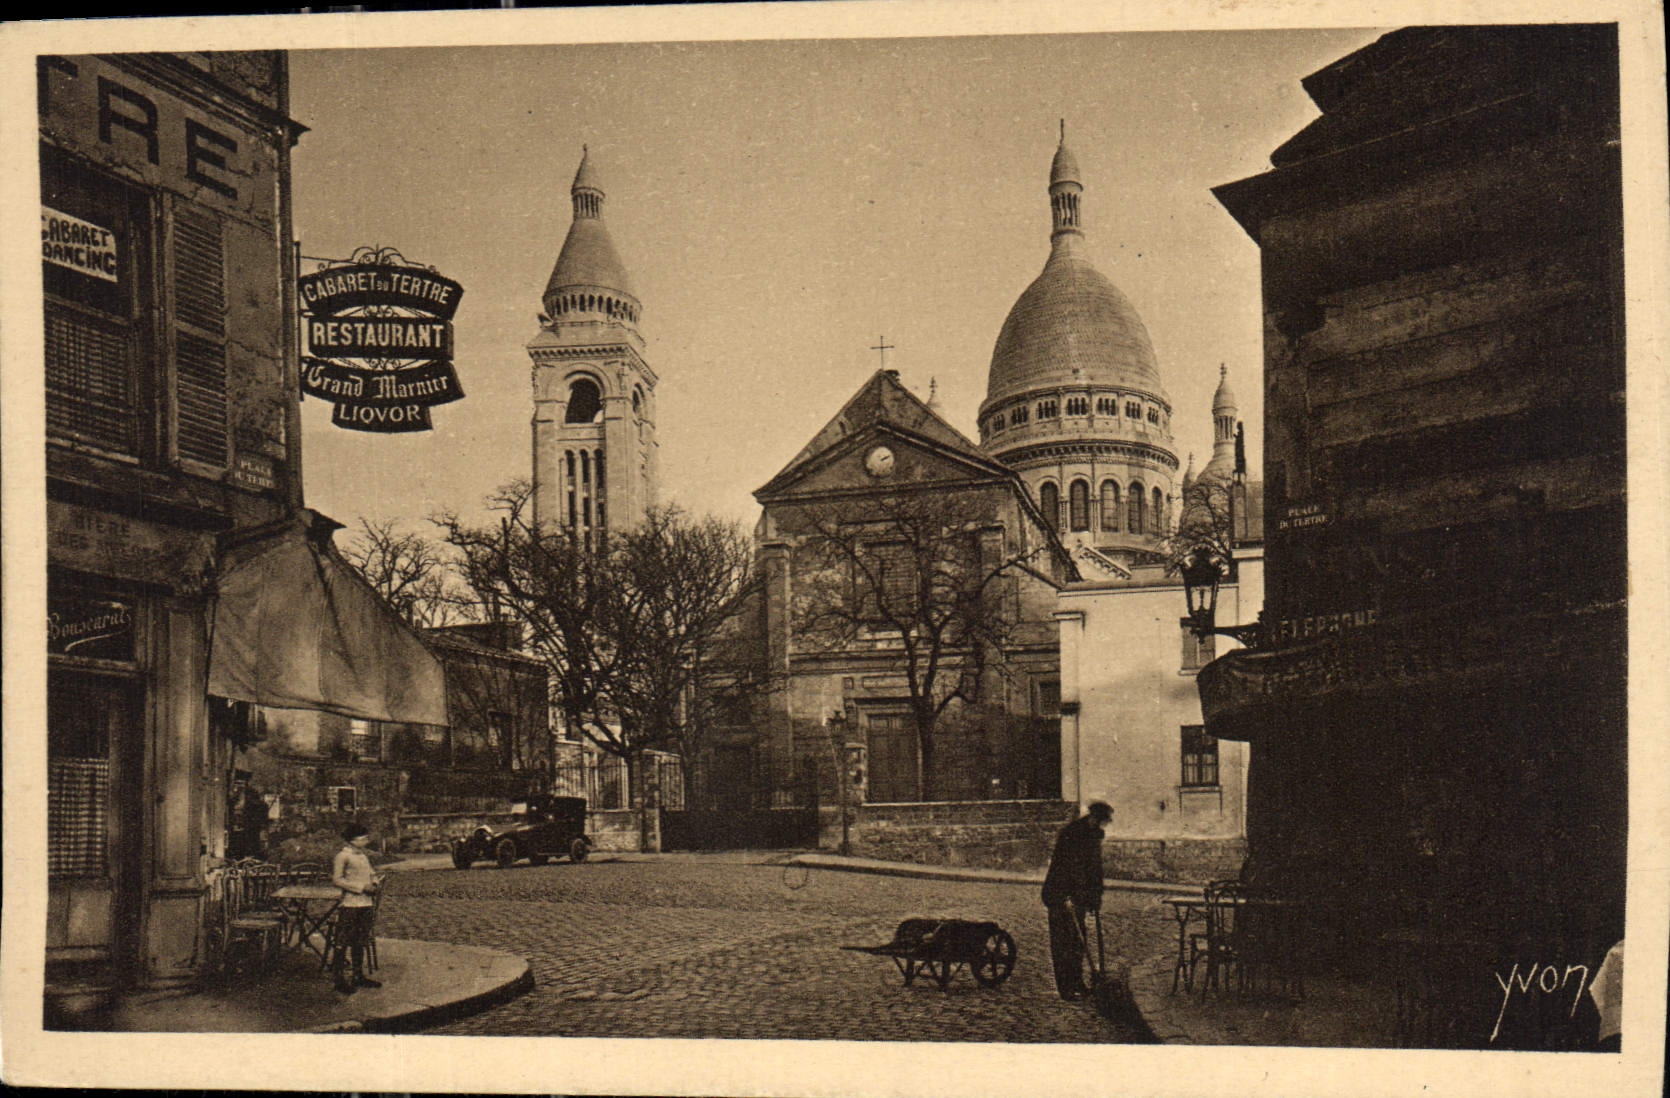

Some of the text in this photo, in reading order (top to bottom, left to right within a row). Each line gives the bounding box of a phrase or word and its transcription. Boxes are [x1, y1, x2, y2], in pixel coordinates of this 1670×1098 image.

[304, 271, 377, 302] CABARET
[390, 273, 453, 304] TERTRE
[312, 322, 444, 348] RESTAURANT
[307, 364, 448, 398] Grand Marnier
[1288, 504, 1319, 517] PLACE
